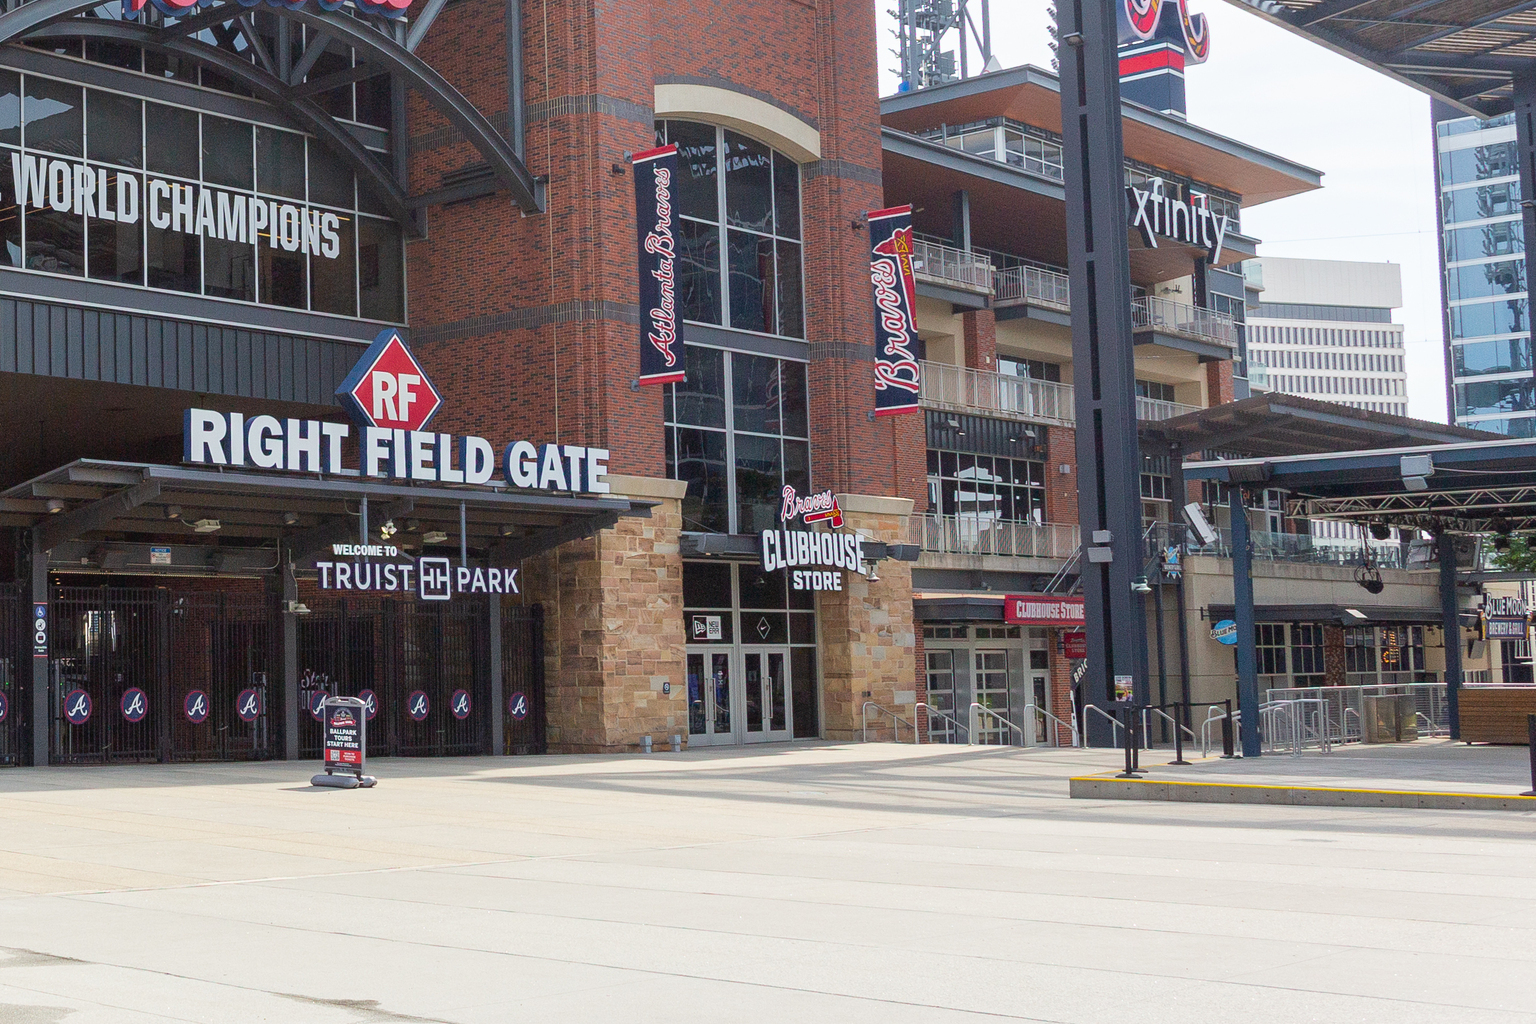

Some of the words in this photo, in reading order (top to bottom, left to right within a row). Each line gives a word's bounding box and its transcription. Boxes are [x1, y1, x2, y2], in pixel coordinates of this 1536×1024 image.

[11, 152, 139, 225] WORLD
[150, 180, 340, 259] CHAMPIONS
[645, 167, 675, 258] Braves
[648, 258, 676, 367] Atlanta
[871, 258, 919, 393] Braves
[372, 371, 422, 422] RF
[186, 407, 349, 474] RIGHT
[366, 426, 495, 484] FIELD
[507, 440, 610, 494] GATE
[781, 484, 831, 522] Braves
[333, 543, 381, 557] WELCOME
[384, 545, 398, 557] TO
[762, 529, 867, 575] CLUBHOUSE
[316, 561, 413, 592] TRUIST
[457, 567, 520, 594] PARK
[793, 570, 843, 591] STORE
[1016, 600, 1060, 619] CLUBHOUSE
[1061, 601, 1085, 619] STORE
[1485, 592, 1506, 620] BLUE
[1506, 596, 1527, 616] MOON
[330, 728, 357, 736] BALLPARK
[344, 741, 359, 749] HERE
